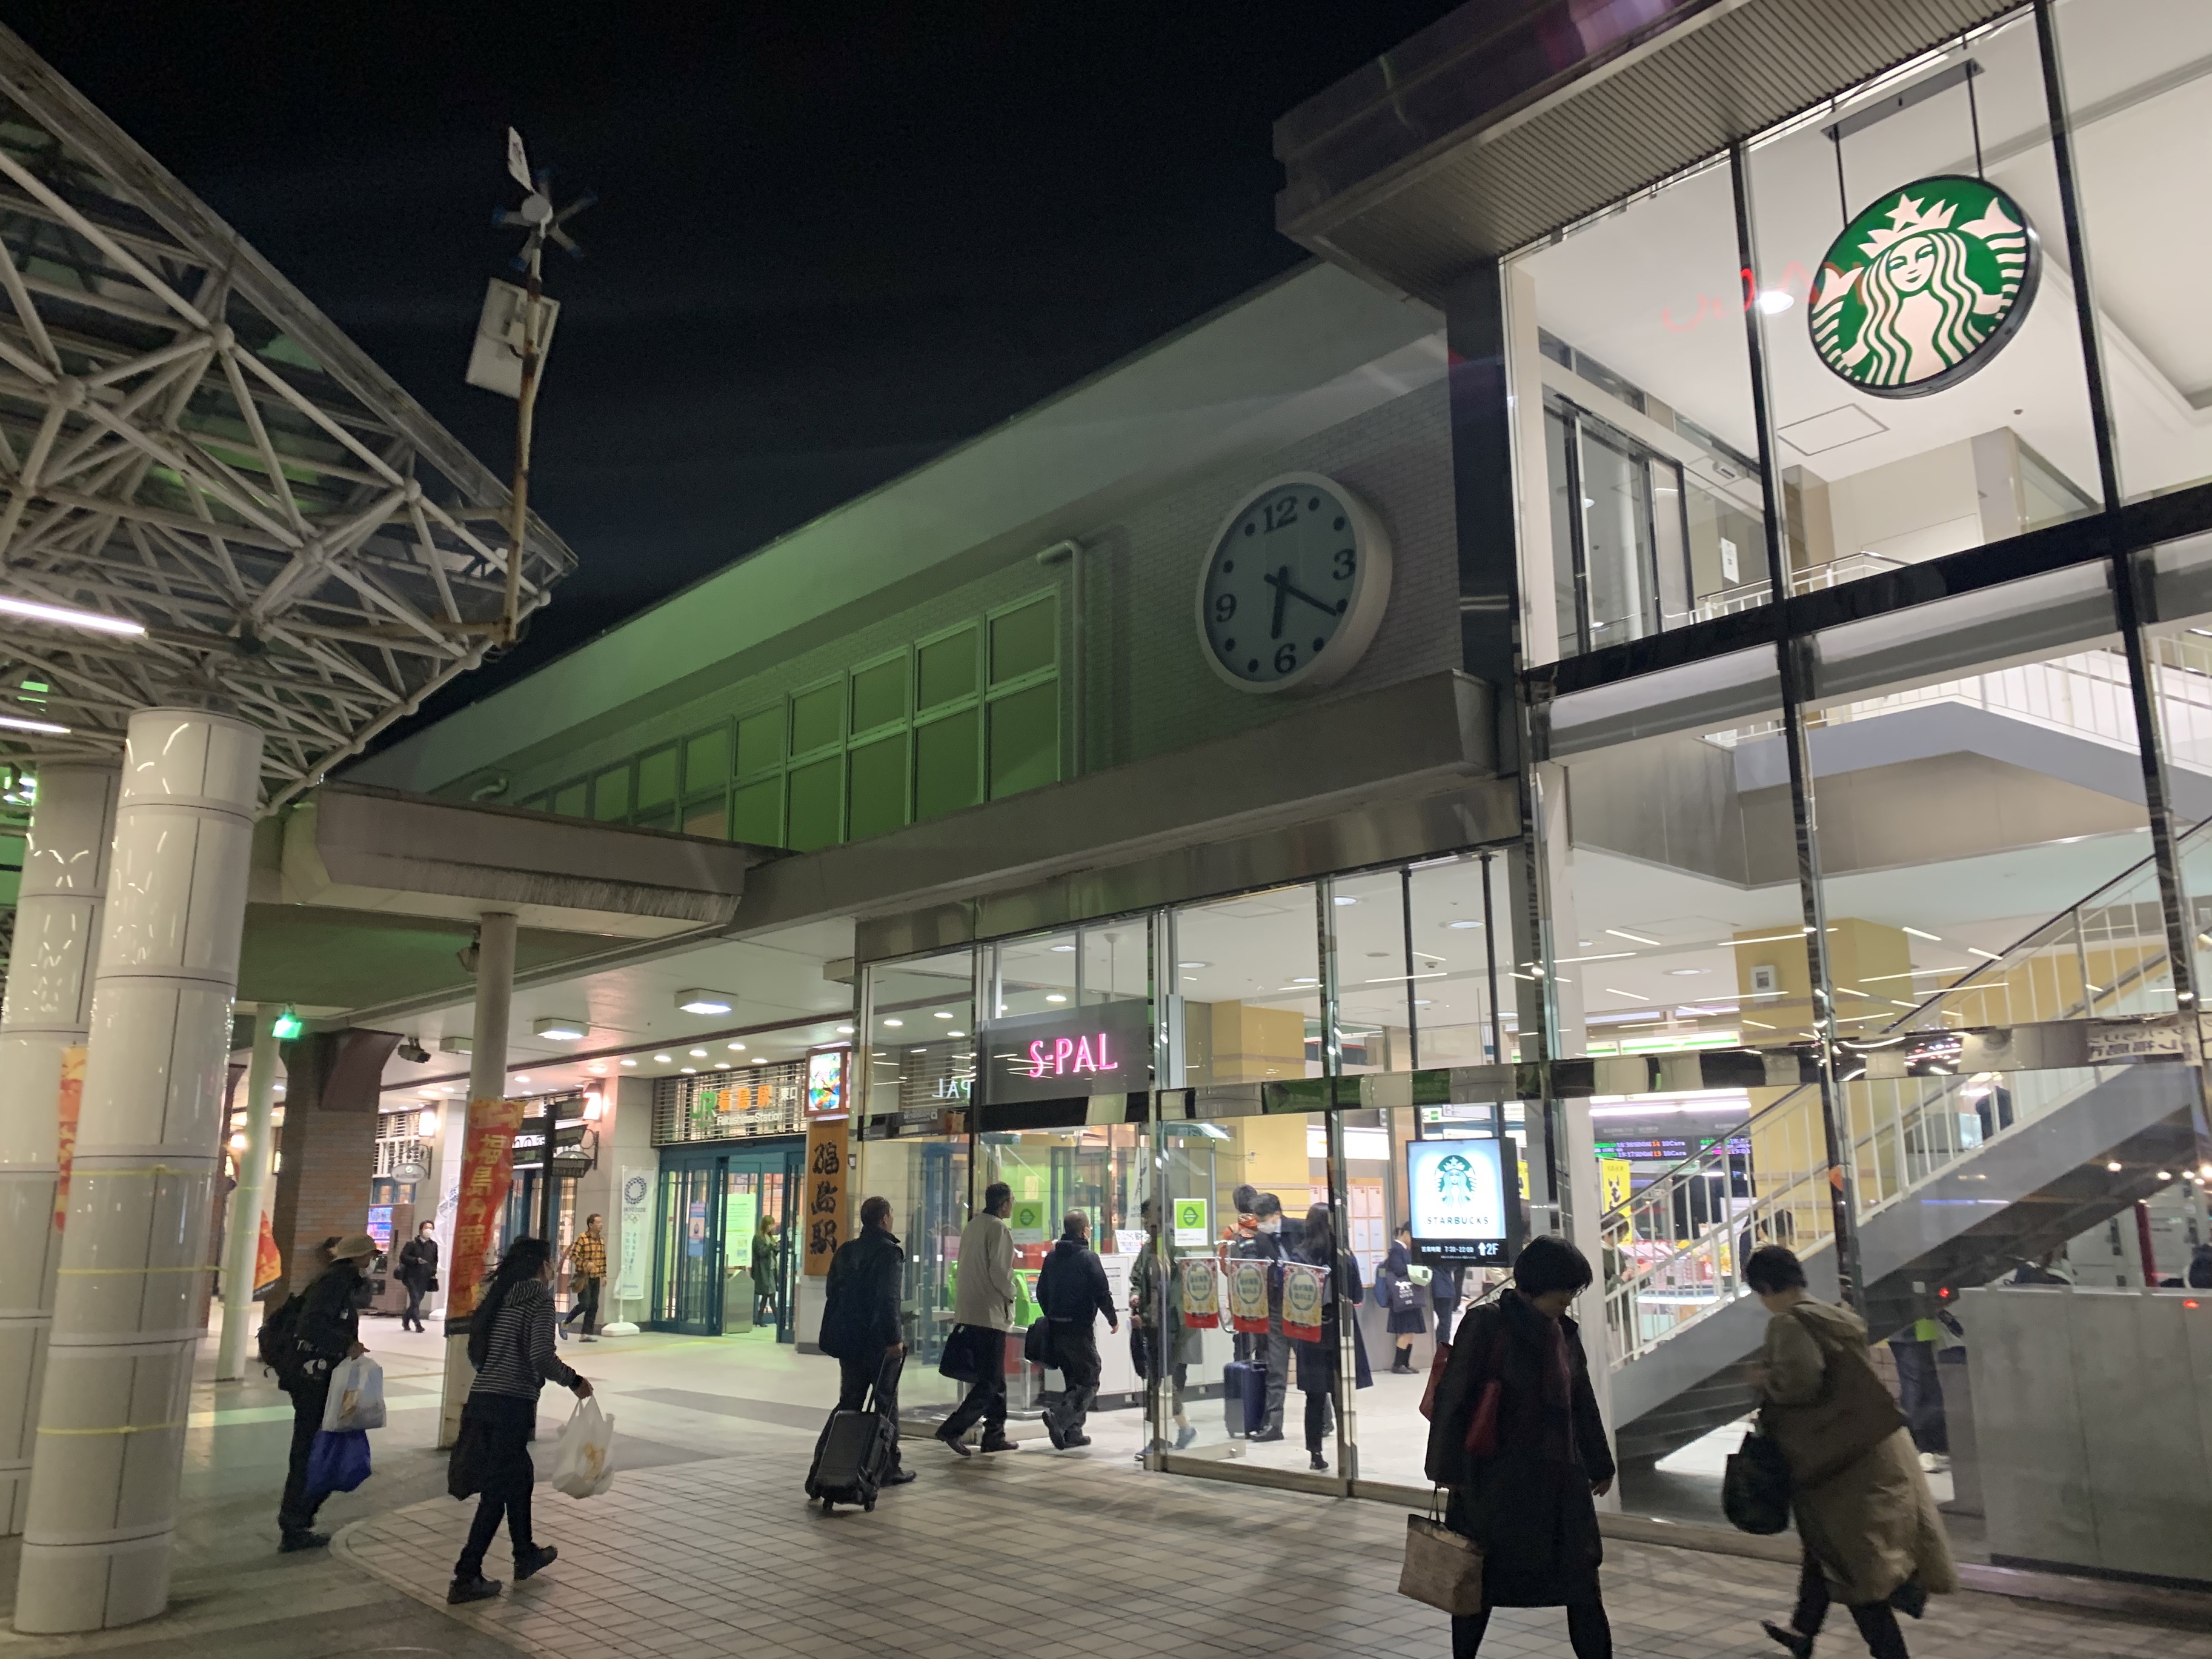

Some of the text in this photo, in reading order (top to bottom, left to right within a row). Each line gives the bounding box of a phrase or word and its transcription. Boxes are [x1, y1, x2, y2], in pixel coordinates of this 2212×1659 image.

[1264, 496, 1298, 534] 12
[1333, 548, 1356, 580] 3
[1215, 593, 1237, 622] 9
[1274, 643, 1297, 674] 6
[1029, 1032, 1118, 1078] S-PAL
[689, 1085, 799, 1119] JR 福島駅 東口
[717, 1111, 783, 1126] Fukushima Station
[810, 1140, 840, 1255] 福島駅
[1427, 1216, 1489, 1225] STARBUCKS
[1486, 1243, 1500, 1255] 2F
